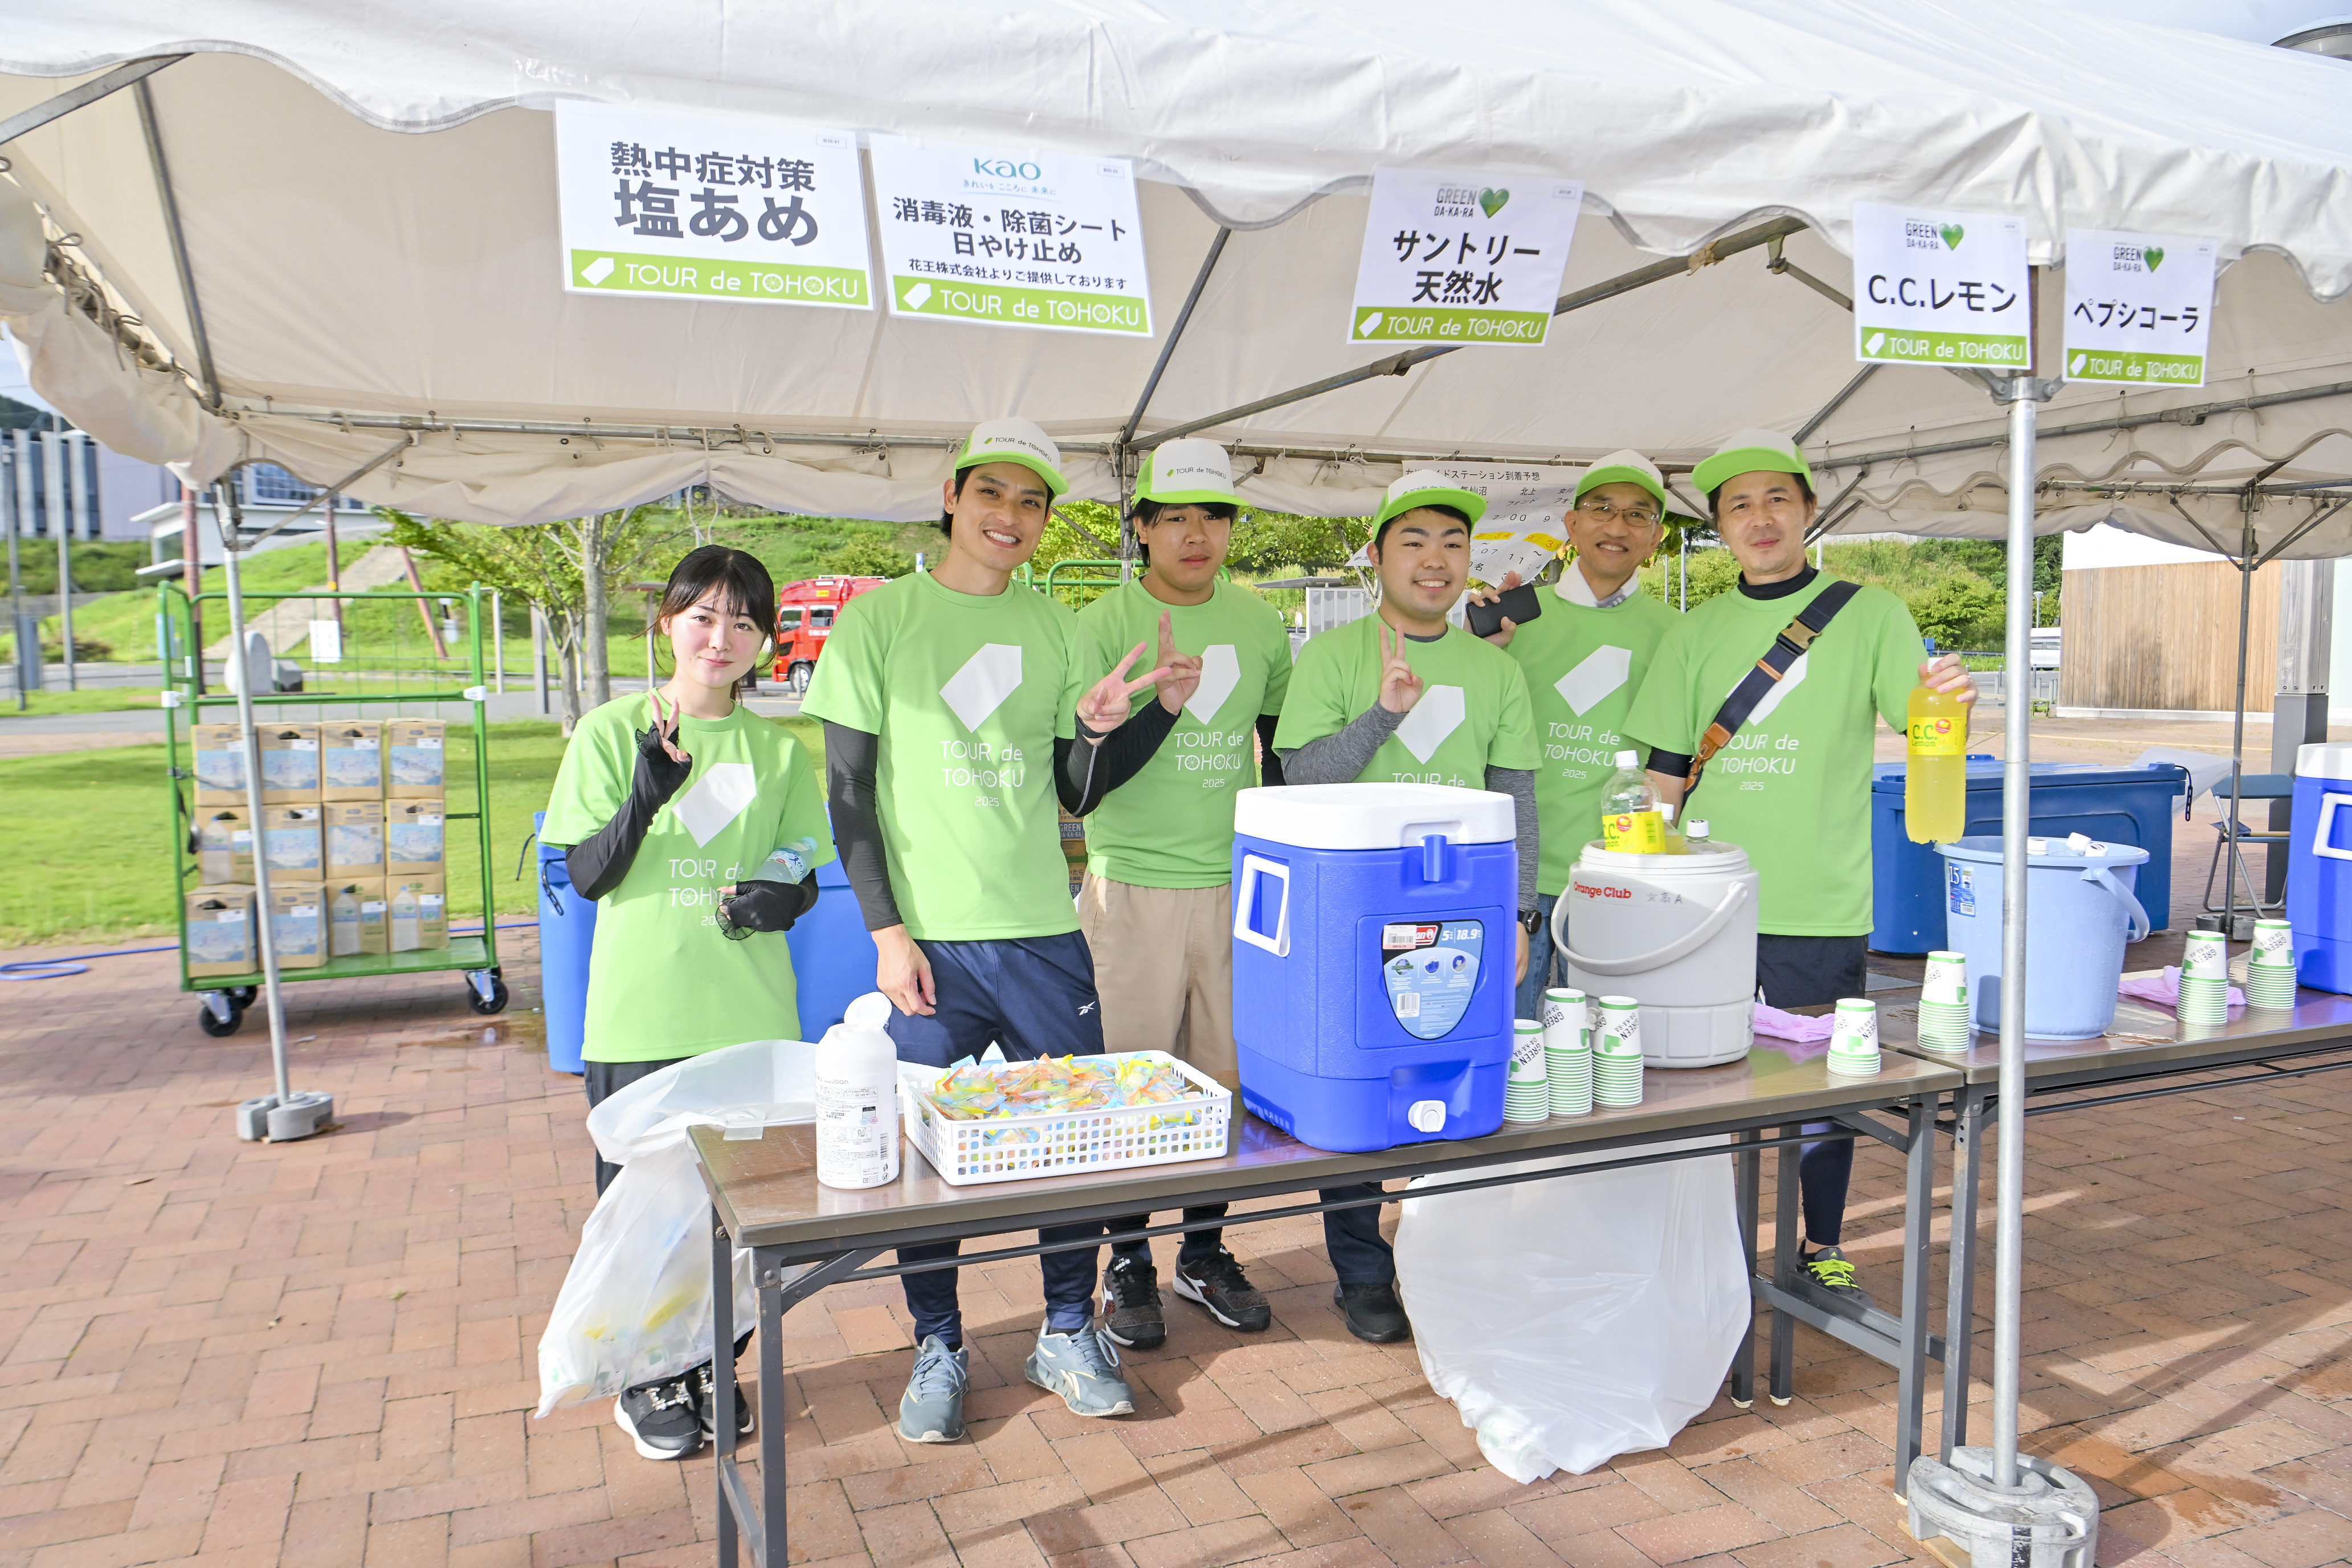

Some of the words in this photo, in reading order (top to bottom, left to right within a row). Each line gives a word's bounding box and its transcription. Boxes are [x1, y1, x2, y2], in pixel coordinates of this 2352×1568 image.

[610, 141, 815, 191] 熱中症対策
[998, 182, 1028, 193] こころに
[1031, 185, 1057, 195] 未来に
[1436, 188, 1477, 205] GREEN
[614, 178, 818, 246] 塩あめ
[893, 195, 1126, 242] 消毒液・除菌シート
[1905, 223, 1938, 239] GREEN
[953, 232, 1083, 265] 日やけ止め
[1394, 230, 1541, 266] サントリー
[2114, 246, 2142, 262] GREEN
[624, 263, 699, 288] TOUR
[709, 269, 741, 292] de
[751, 271, 859, 299] TOHOKU
[908, 258, 1127, 290] 花王株式会社よりご提供しております
[1411, 270, 1504, 305] 天然水
[1868, 274, 2016, 313] C.C.レモン
[940, 288, 1003, 315] TOUR
[1012, 295, 1040, 319] de
[1046, 299, 1140, 327] TOHOKU
[2073, 297, 2199, 333] ペプシコーラ
[1387, 315, 1435, 335] TOUR
[1439, 318, 1461, 336] de
[1467, 318, 1542, 338] TOHOKU
[1889, 337, 1930, 357] TOUR
[1936, 341, 1955, 358] de
[1959, 342, 2023, 361] TOHOKU
[2089, 358, 2123, 375] TOUR
[2127, 361, 2142, 377] de
[2146, 361, 2199, 379] TOHOKU
[1028, 442, 1052, 462] TOHOKU
[1206, 468, 1226, 479] TOHOKU
[1405, 468, 1541, 481] 女ドステーション到着予想
[1520, 487, 1536, 496] 北上
[1174, 732, 1223, 748] TOUR
[1227, 730, 1243, 746] de
[1548, 722, 1593, 741] TOUR
[1599, 729, 1620, 745] de
[1912, 724, 1938, 740] C.C.
[940, 740, 991, 761] TOUR
[1001, 742, 1023, 761] de
[1722, 734, 1769, 750] OUR
[1775, 734, 1799, 750] de
[1175, 753, 1241, 771] TOHOKU
[1545, 744, 1616, 767] TOHOKU
[1562, 769, 1587, 779] 2025
[1721, 757, 1796, 774] TOHOKU
[942, 767, 1023, 788] TOHOKU
[1202, 778, 1225, 788] 2025
[1392, 773, 1442, 785] TOUR
[1740, 781, 1765, 791] 2025
[974, 796, 999, 807] 2025
[1059, 823, 1081, 832] GREEN
[668, 858, 717, 879] TOUR
[725, 861, 744, 880] de
[1574, 881, 1602, 899] Orange
[1604, 887, 1632, 899] Club
[1442, 930, 1450, 941] 5
[1456, 929, 1479, 940] 18.9
[2264, 937, 2288, 953] GREEN
[2193, 949, 2218, 965] GREEN
[1518, 1043, 1542, 1066] GREEN
